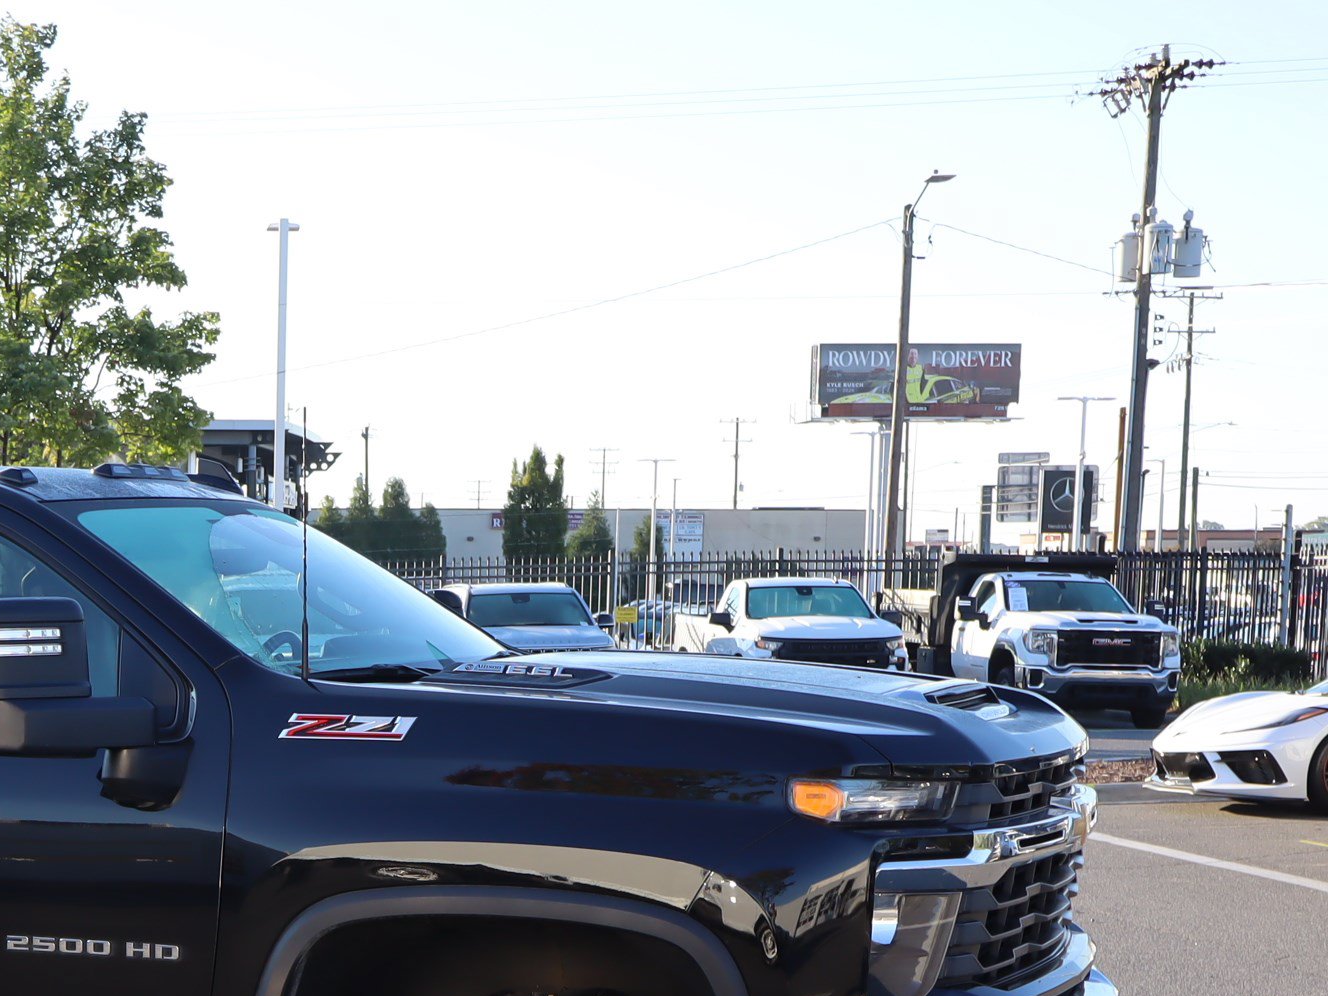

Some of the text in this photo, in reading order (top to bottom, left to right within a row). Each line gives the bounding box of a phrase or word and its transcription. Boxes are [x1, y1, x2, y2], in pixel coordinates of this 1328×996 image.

[828, 350, 1012, 367] ROWDY FOREVER
[1092, 638, 1131, 646] GMC
[506, 664, 573, 677] 6.6L
[278, 713, 418, 742] Z71
[6, 935, 180, 960] 2500 HD
